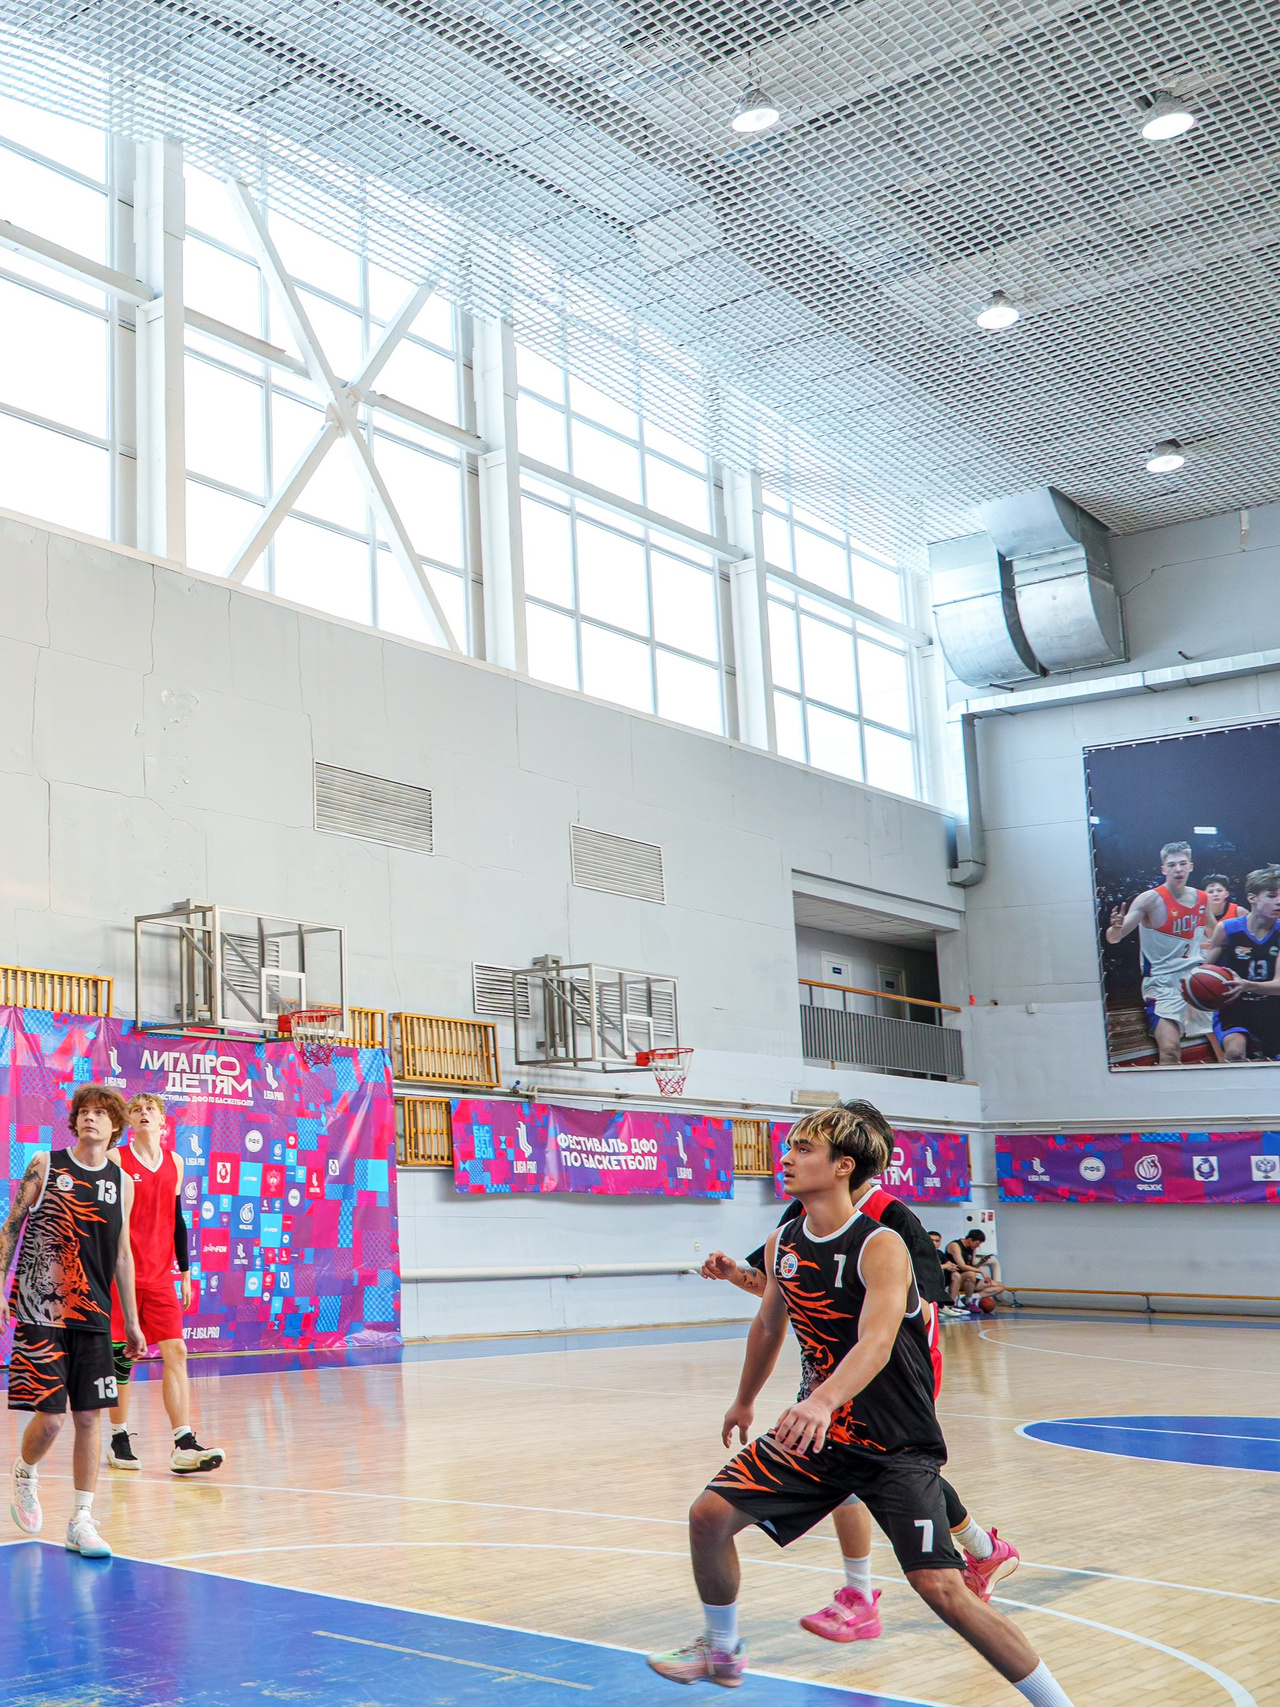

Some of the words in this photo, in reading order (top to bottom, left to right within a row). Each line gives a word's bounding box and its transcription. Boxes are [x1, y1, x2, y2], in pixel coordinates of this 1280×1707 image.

[165, 1071, 253, 1098] ДЕТЯМ
[472, 1125, 490, 1136] БАС
[474, 1136, 490, 1148] КЕТ
[556, 1132, 628, 1153] ФЕСТИВАЛЬ
[630, 1138, 658, 1154] ДФО
[475, 1147, 494, 1159] БОЛ
[561, 1150, 581, 1167] ПО
[581, 1153, 658, 1171] БАСКЕТБОЛУ
[513, 1160, 527, 1173] LIGA
[527, 1160, 537, 1173] PRO
[95, 1179, 118, 1205] 13
[1136, 1183, 1163, 1192] ФБХК
[833, 1253, 847, 1289] 7
[93, 1375, 118, 1400] 13
[913, 1519, 934, 1553] 7
